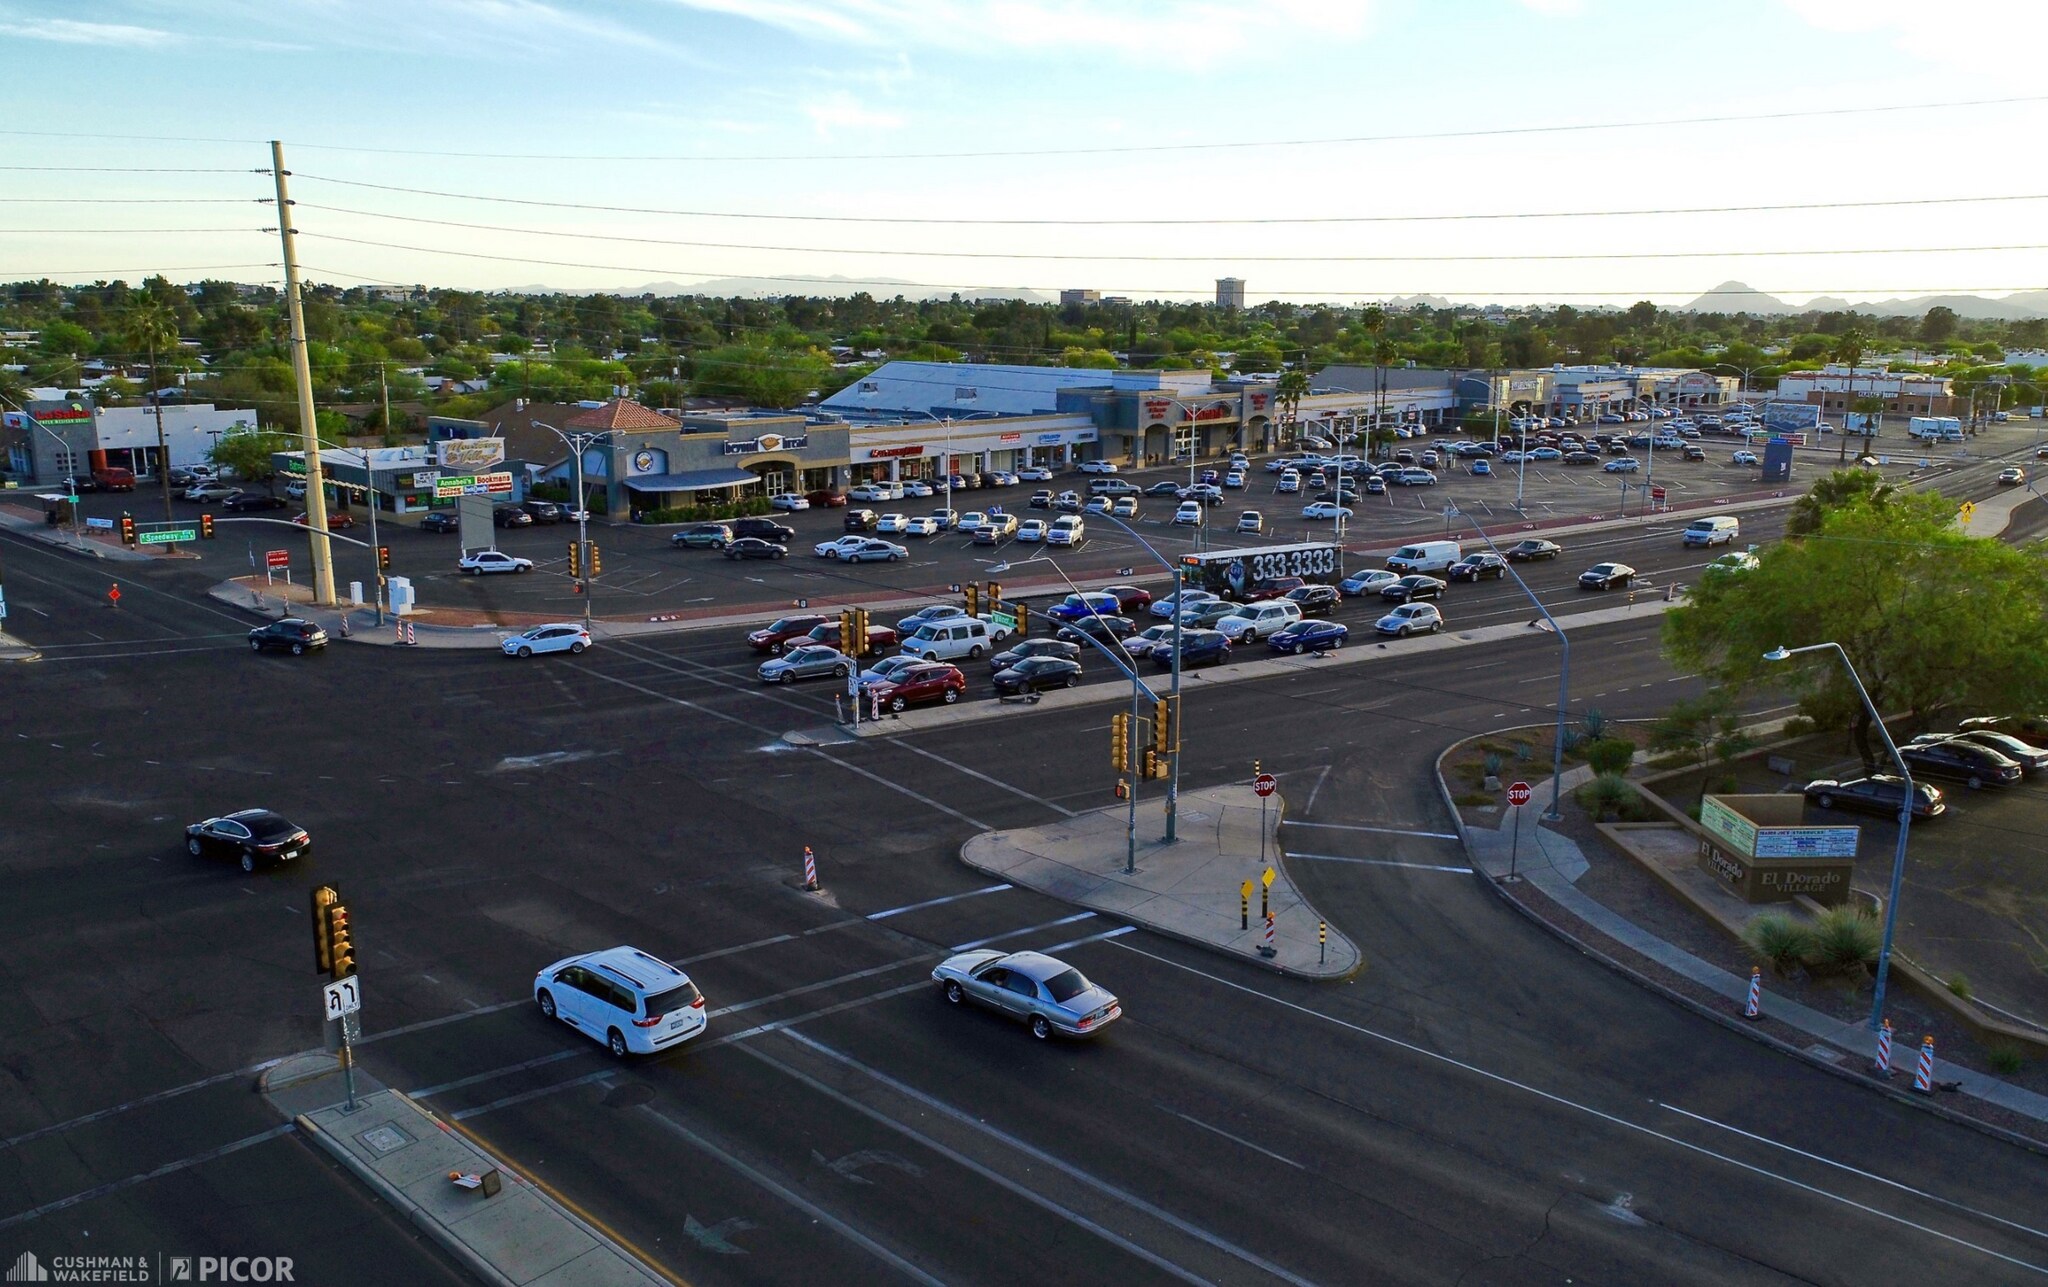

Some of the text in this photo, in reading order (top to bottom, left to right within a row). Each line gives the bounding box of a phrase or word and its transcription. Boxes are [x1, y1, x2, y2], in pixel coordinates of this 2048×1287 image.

[35, 409, 90, 419] La Salsa
[477, 475, 510, 484] Bookmans
[146, 532, 178, 542] Speedway
[1253, 549, 1335, 581] 333-3333
[1255, 780, 1275, 791] STOP
[1508, 790, 1530, 799] STOP
[1701, 841, 1743, 879] El Dorado
[1707, 857, 1735, 883] VILLAGE
[1761, 871, 1841, 885] El Dorado
[1776, 884, 1825, 892] VILLAGE
